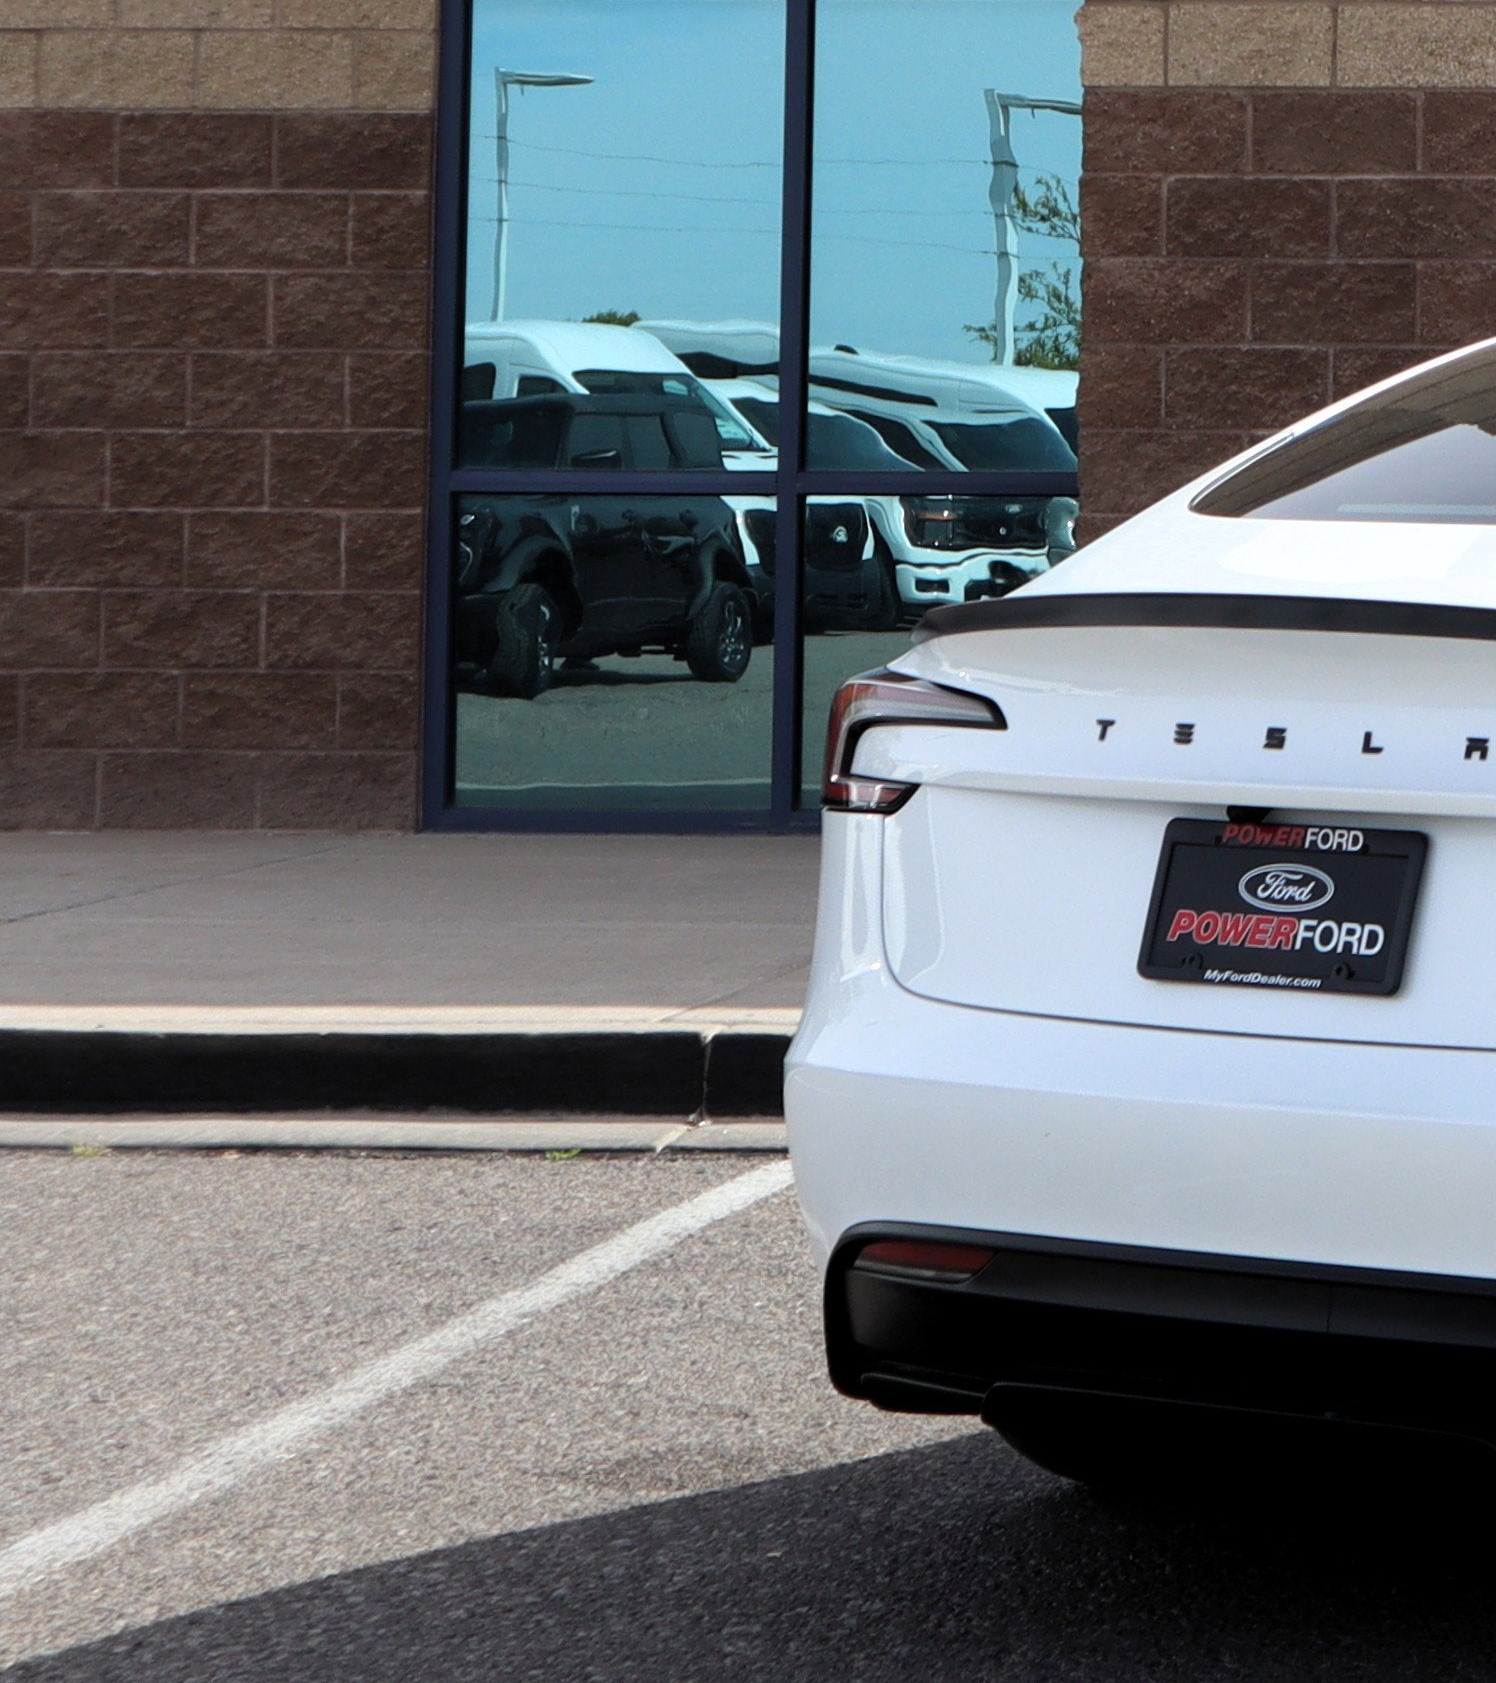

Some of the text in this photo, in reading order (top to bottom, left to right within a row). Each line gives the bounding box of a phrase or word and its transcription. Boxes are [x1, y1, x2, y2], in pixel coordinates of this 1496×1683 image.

[1096, 719, 1490, 761] TESLA
[1222, 822, 1365, 852] POWERFORD
[1256, 870, 1316, 902] Ford
[1166, 909, 1385, 956] POWERFORD
[1203, 969, 1322, 989] MyFordDealer.com
